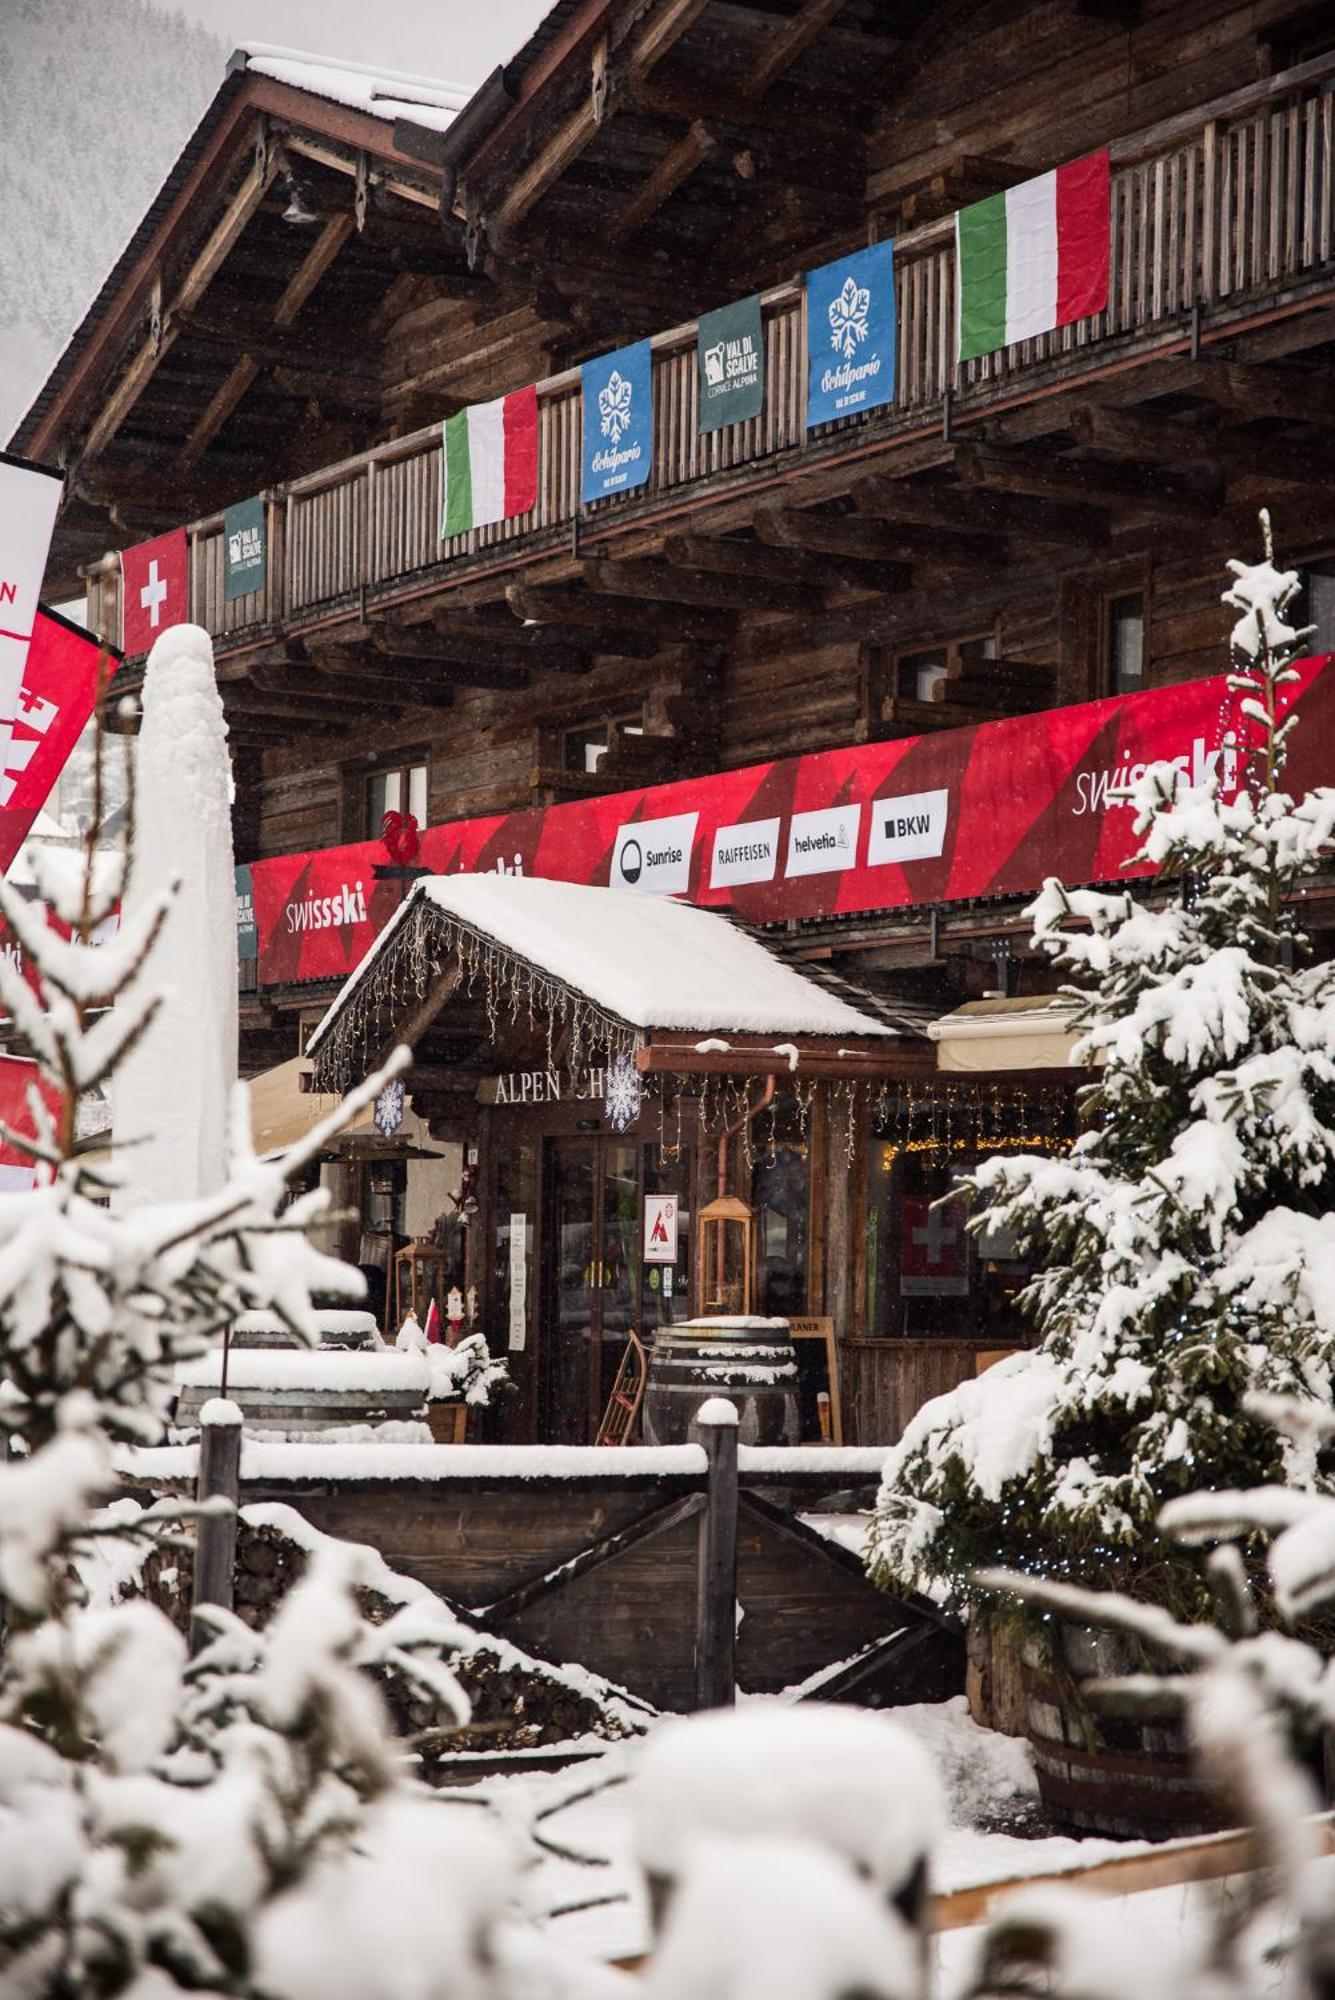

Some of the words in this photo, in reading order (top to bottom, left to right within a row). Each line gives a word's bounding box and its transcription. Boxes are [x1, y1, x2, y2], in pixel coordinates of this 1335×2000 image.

[727, 340, 742, 359] VAL
[743, 336, 752, 354] DI
[727, 352, 758, 378] SCALVE
[821, 353, 880, 393] Schilpario
[708, 381, 731, 399] CORNICE
[733, 373, 758, 390] ALPINA
[592, 440, 641, 473] Schilpario
[897, 814, 930, 837] BKW
[646, 845, 683, 867] Sunrise
[718, 842, 771, 865] RAIFFEISEN
[795, 833, 836, 853] helvetia
[286, 880, 368, 934] swissski
[495, 1070, 561, 1104] ALPEN
